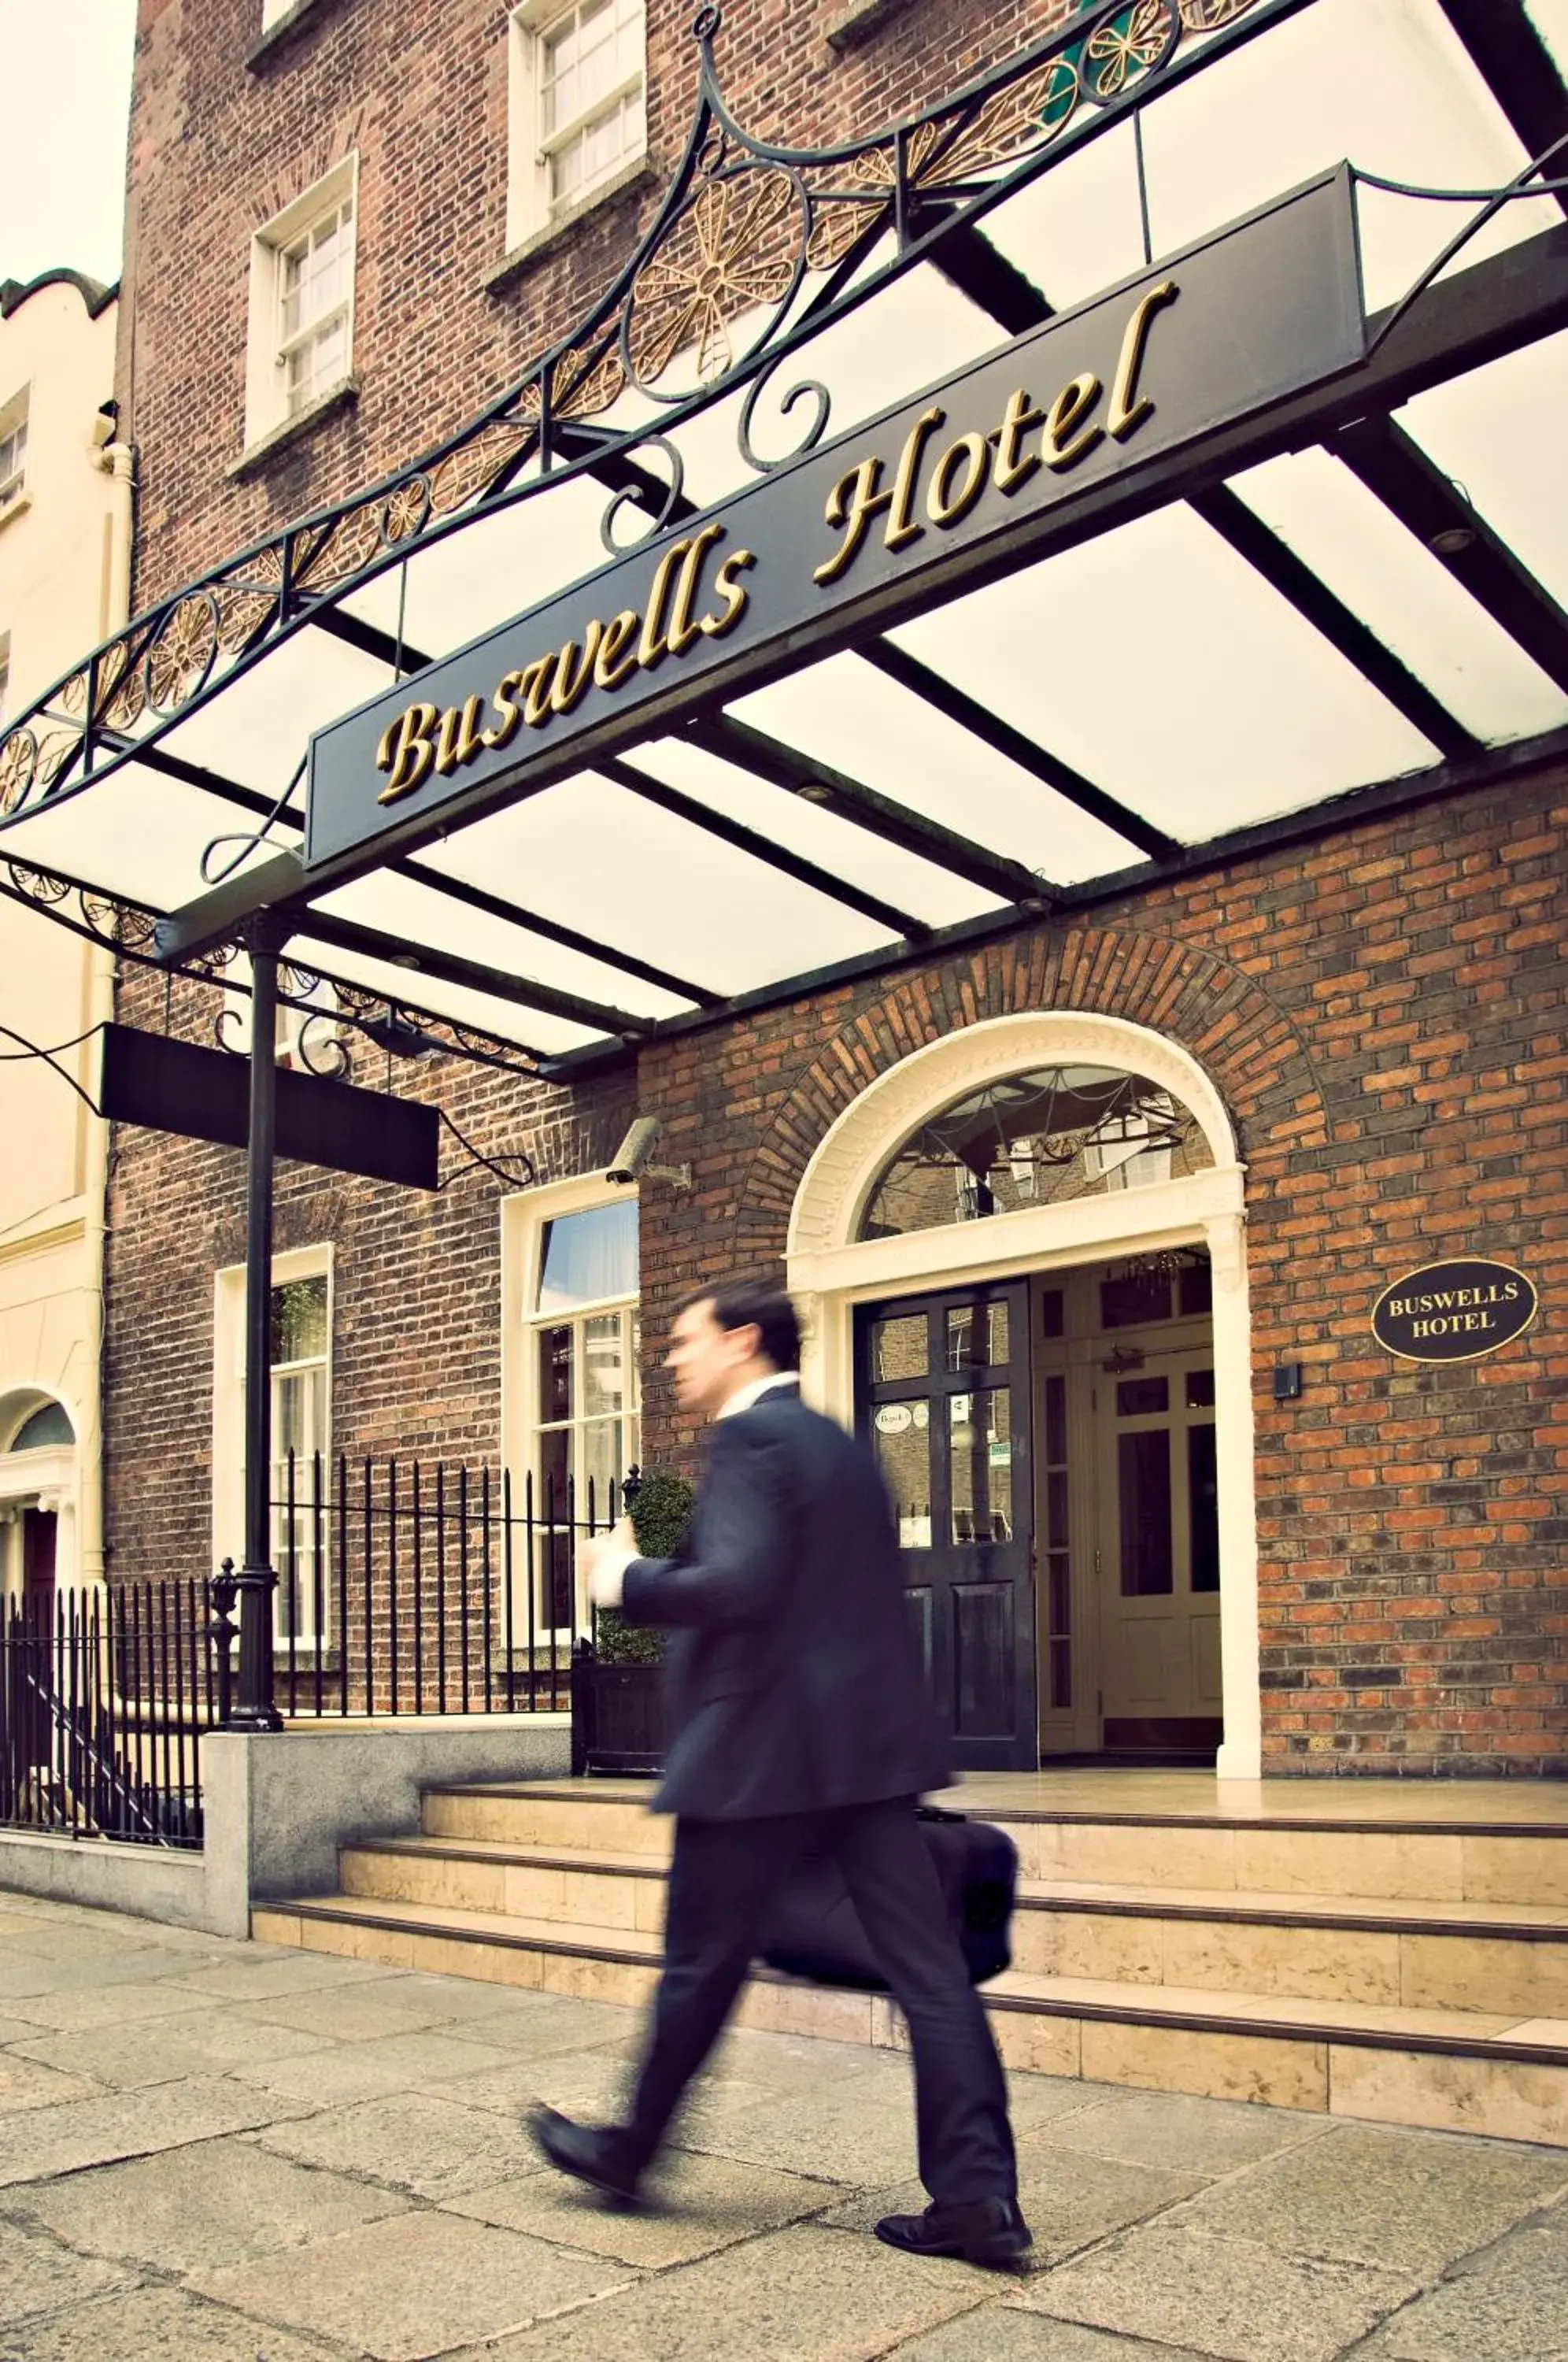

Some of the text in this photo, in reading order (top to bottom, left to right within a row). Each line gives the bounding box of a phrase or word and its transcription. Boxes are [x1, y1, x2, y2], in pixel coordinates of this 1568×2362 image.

[376, 280, 1178, 805] Buswells Hotel
[1389, 1283, 1518, 1316] BUSWELLS
[1413, 1312, 1496, 1338] HOTEL
